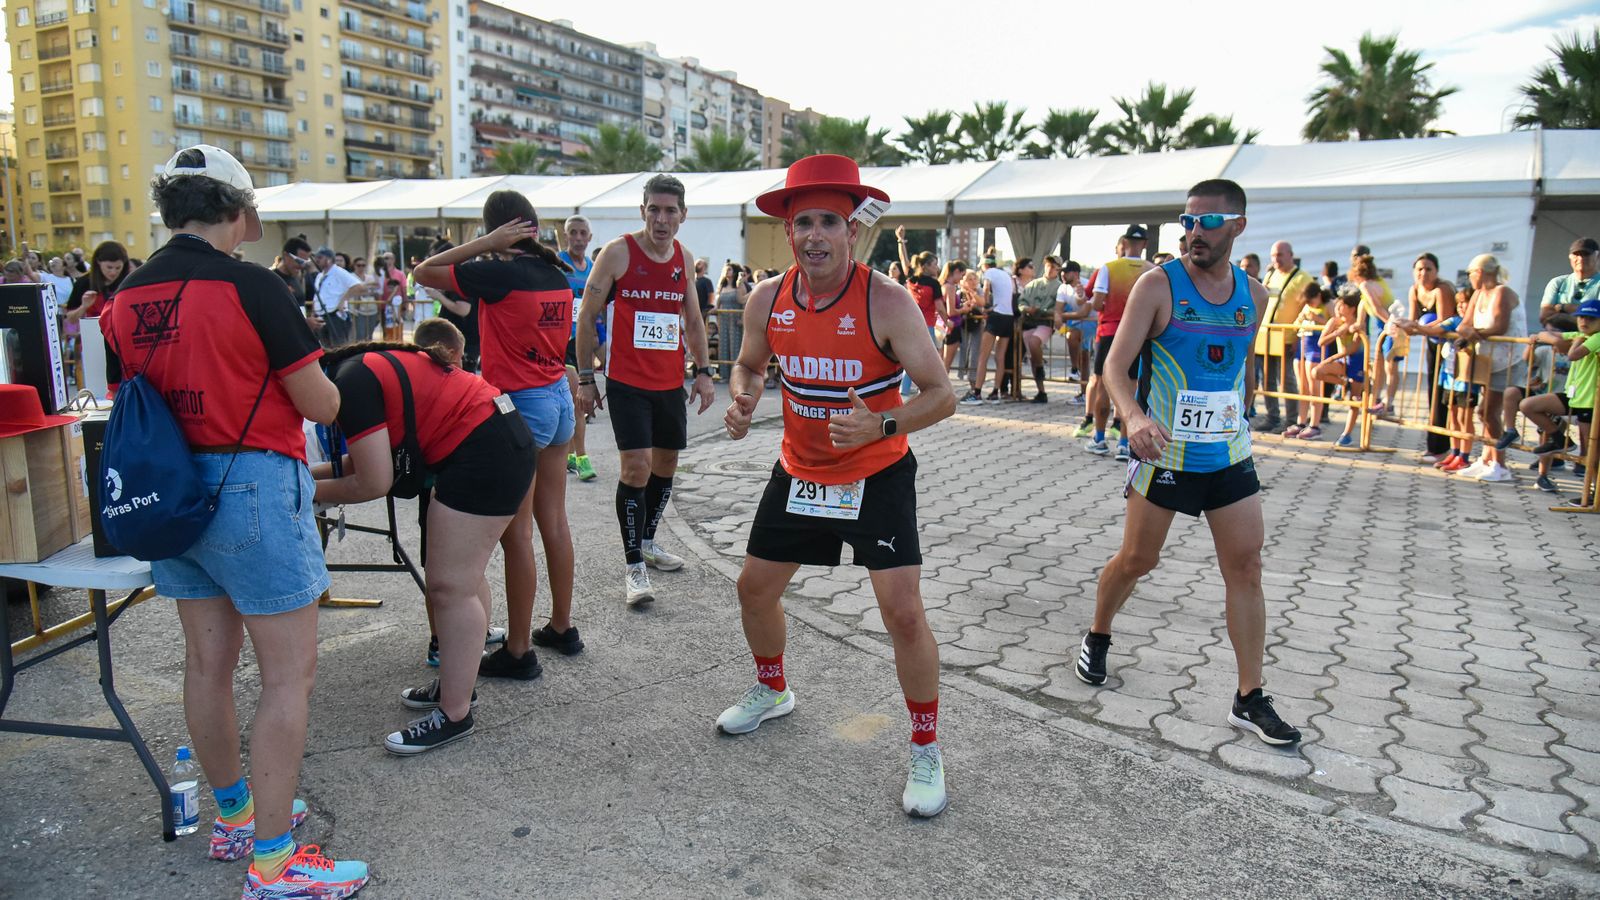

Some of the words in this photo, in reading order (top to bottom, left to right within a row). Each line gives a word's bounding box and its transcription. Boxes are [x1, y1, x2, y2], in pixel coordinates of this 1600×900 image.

[621, 289, 651, 299] SAN
[654, 290, 684, 302] PEDR
[539, 301, 567, 321] XXI
[641, 325, 663, 339] 743
[1180, 408, 1215, 429] 517
[131, 491, 160, 509] Port
[795, 480, 827, 502] 291
